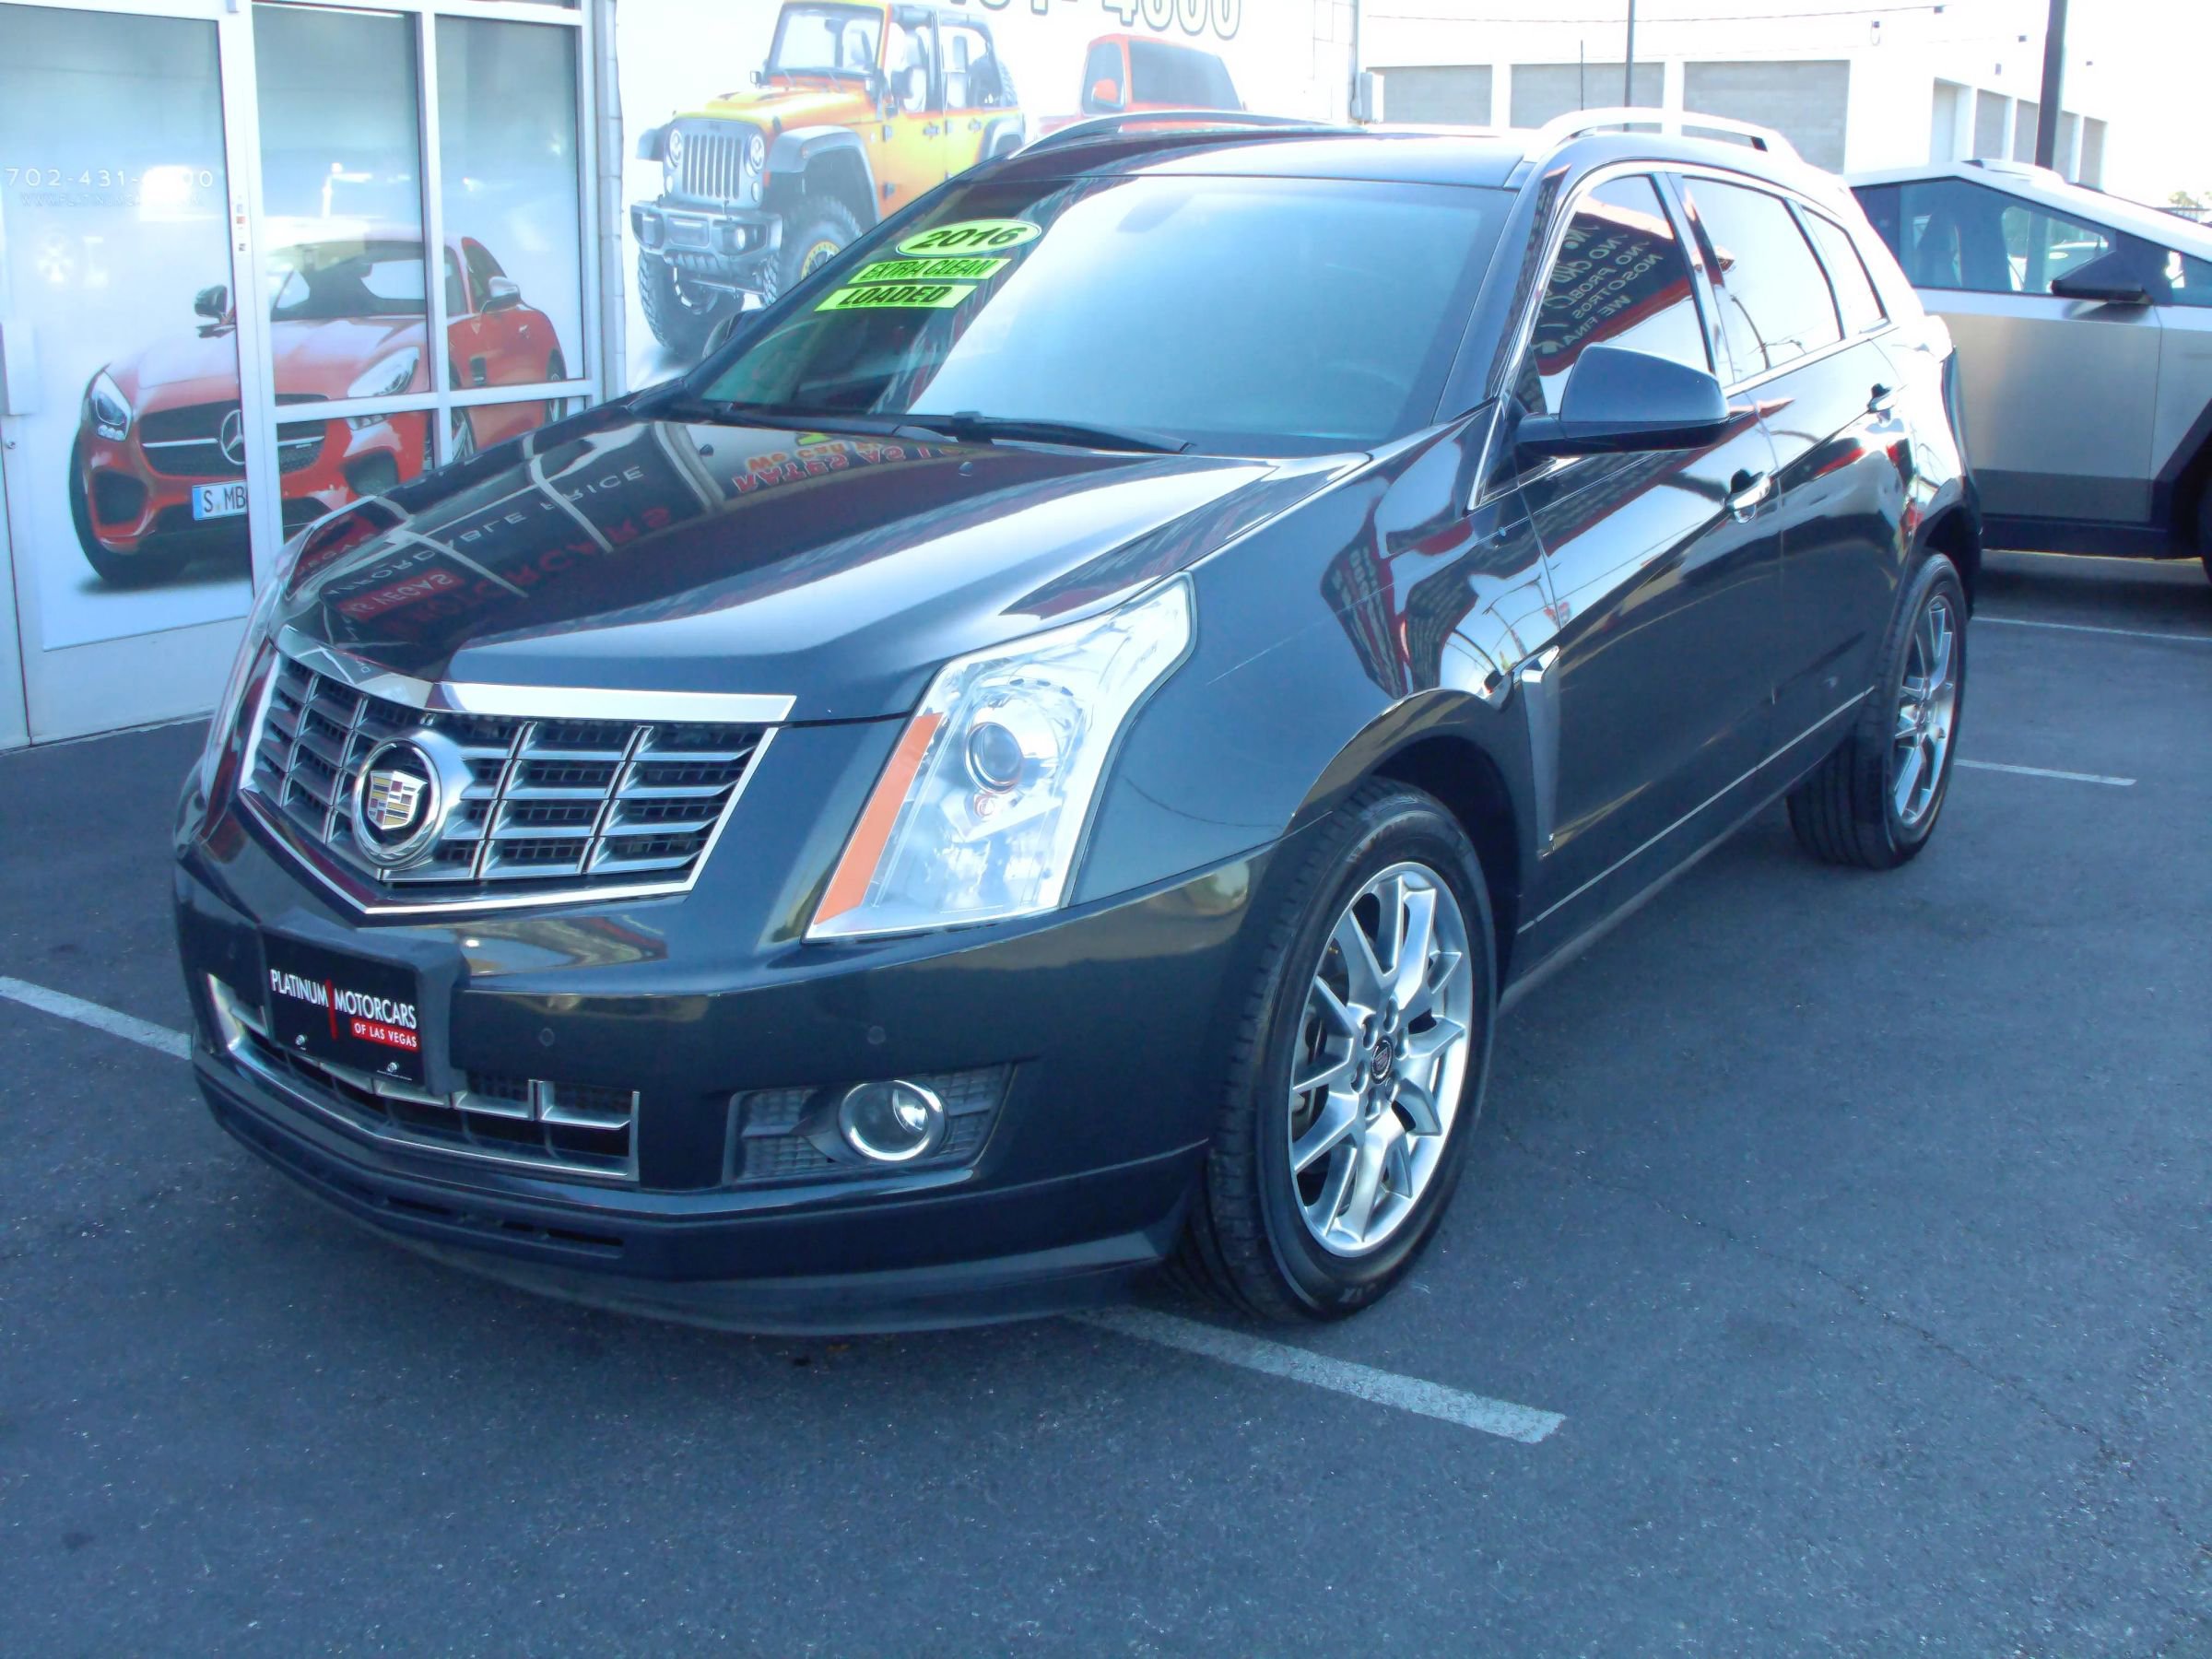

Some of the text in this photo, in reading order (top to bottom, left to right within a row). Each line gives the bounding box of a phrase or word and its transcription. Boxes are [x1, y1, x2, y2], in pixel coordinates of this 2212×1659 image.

[5, 168, 214, 188] 702-431-00
[907, 227, 1028, 250] 2016
[860, 259, 999, 281] EXTRA CLEAN
[836, 286, 954, 308] LOADED
[203, 485, 248, 513] S MB
[270, 969, 418, 1030] PLATINUM MOTORCARS
[354, 1022, 418, 1048] OF LAS VEGAS
